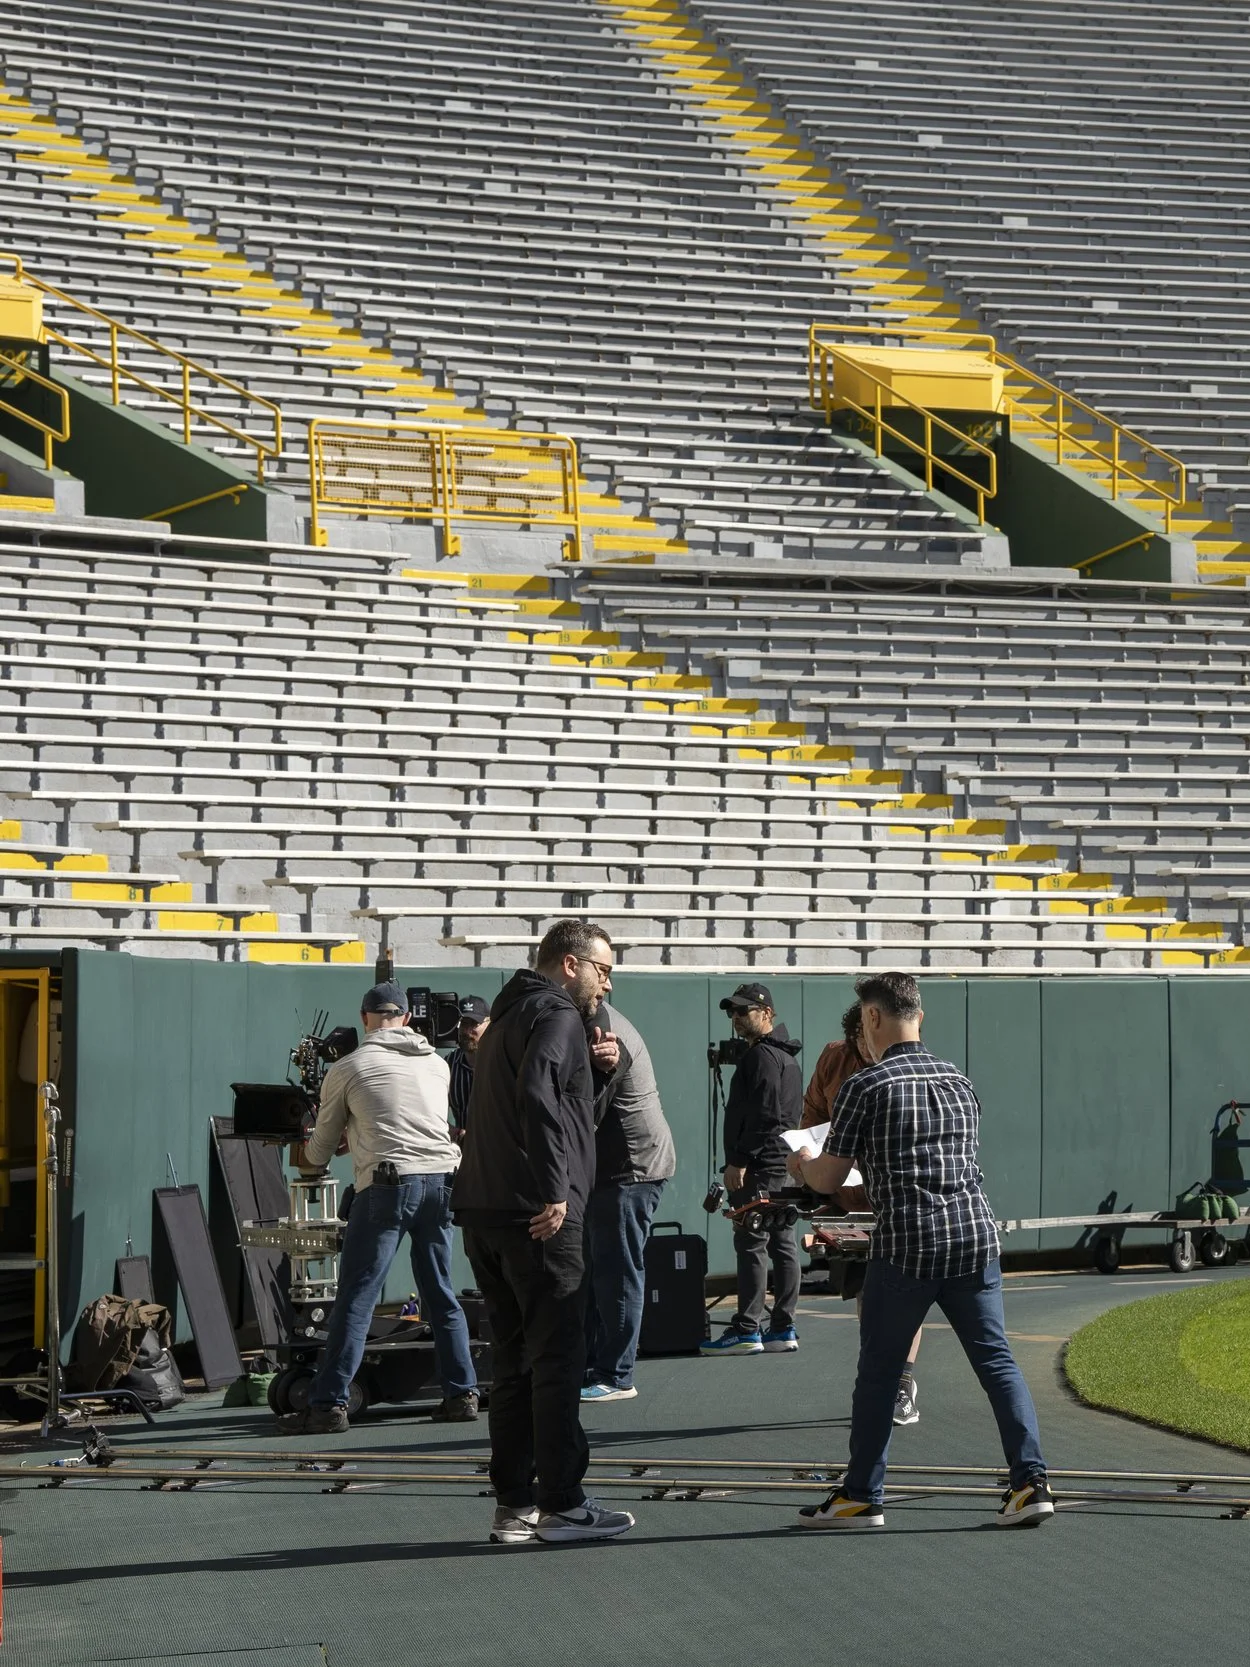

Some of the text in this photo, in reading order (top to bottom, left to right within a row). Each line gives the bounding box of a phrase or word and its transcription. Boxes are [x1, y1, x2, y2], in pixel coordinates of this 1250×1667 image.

[966, 424, 993, 438] 102
[472, 578, 482, 588] 21
[602, 656, 613, 665] 18
[649, 678, 658, 687] 17
[697, 701, 708, 710] 16
[746, 725, 755, 735] 15
[791, 750, 802, 759] 14
[894, 800, 903, 808] 12
[1053, 878, 1059, 888] 9
[129, 888, 136, 900] 8
[1107, 903, 1113, 912] 8
[217, 919, 224, 931] 7
[1162, 928, 1168, 937] 7
[302, 948, 309, 960] 6
[1219, 952, 1225, 962] 6
[412, 1005, 426, 1018] LE
